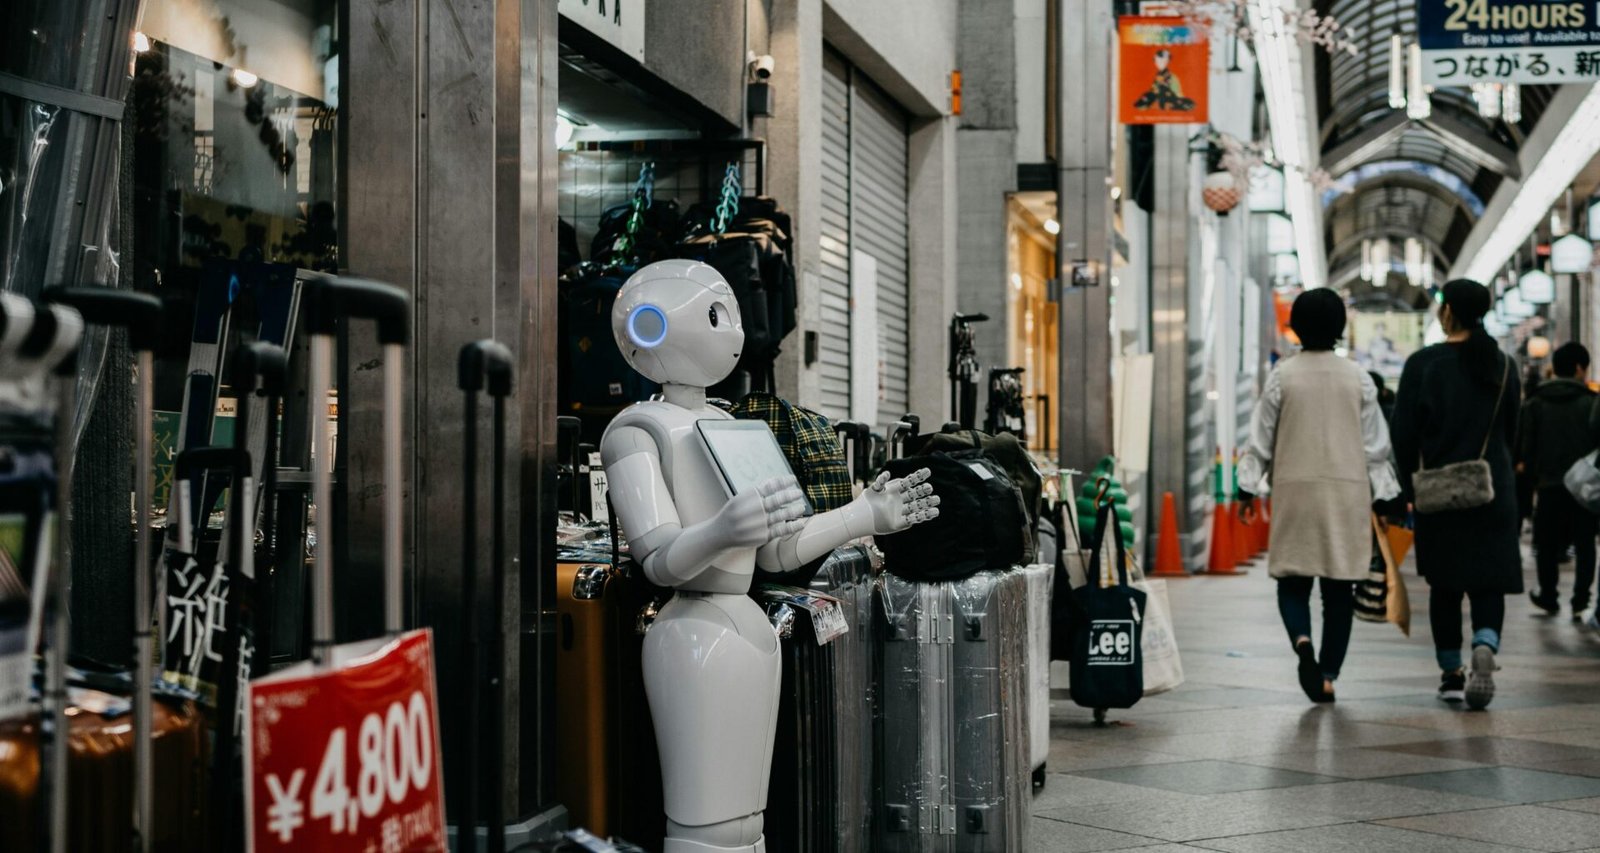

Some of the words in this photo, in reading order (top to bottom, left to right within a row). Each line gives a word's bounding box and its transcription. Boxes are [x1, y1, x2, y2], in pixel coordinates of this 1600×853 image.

[1463, 33, 1489, 46] Easy
[1534, 31, 1588, 42] Available
[1088, 631, 1130, 655] Lee
